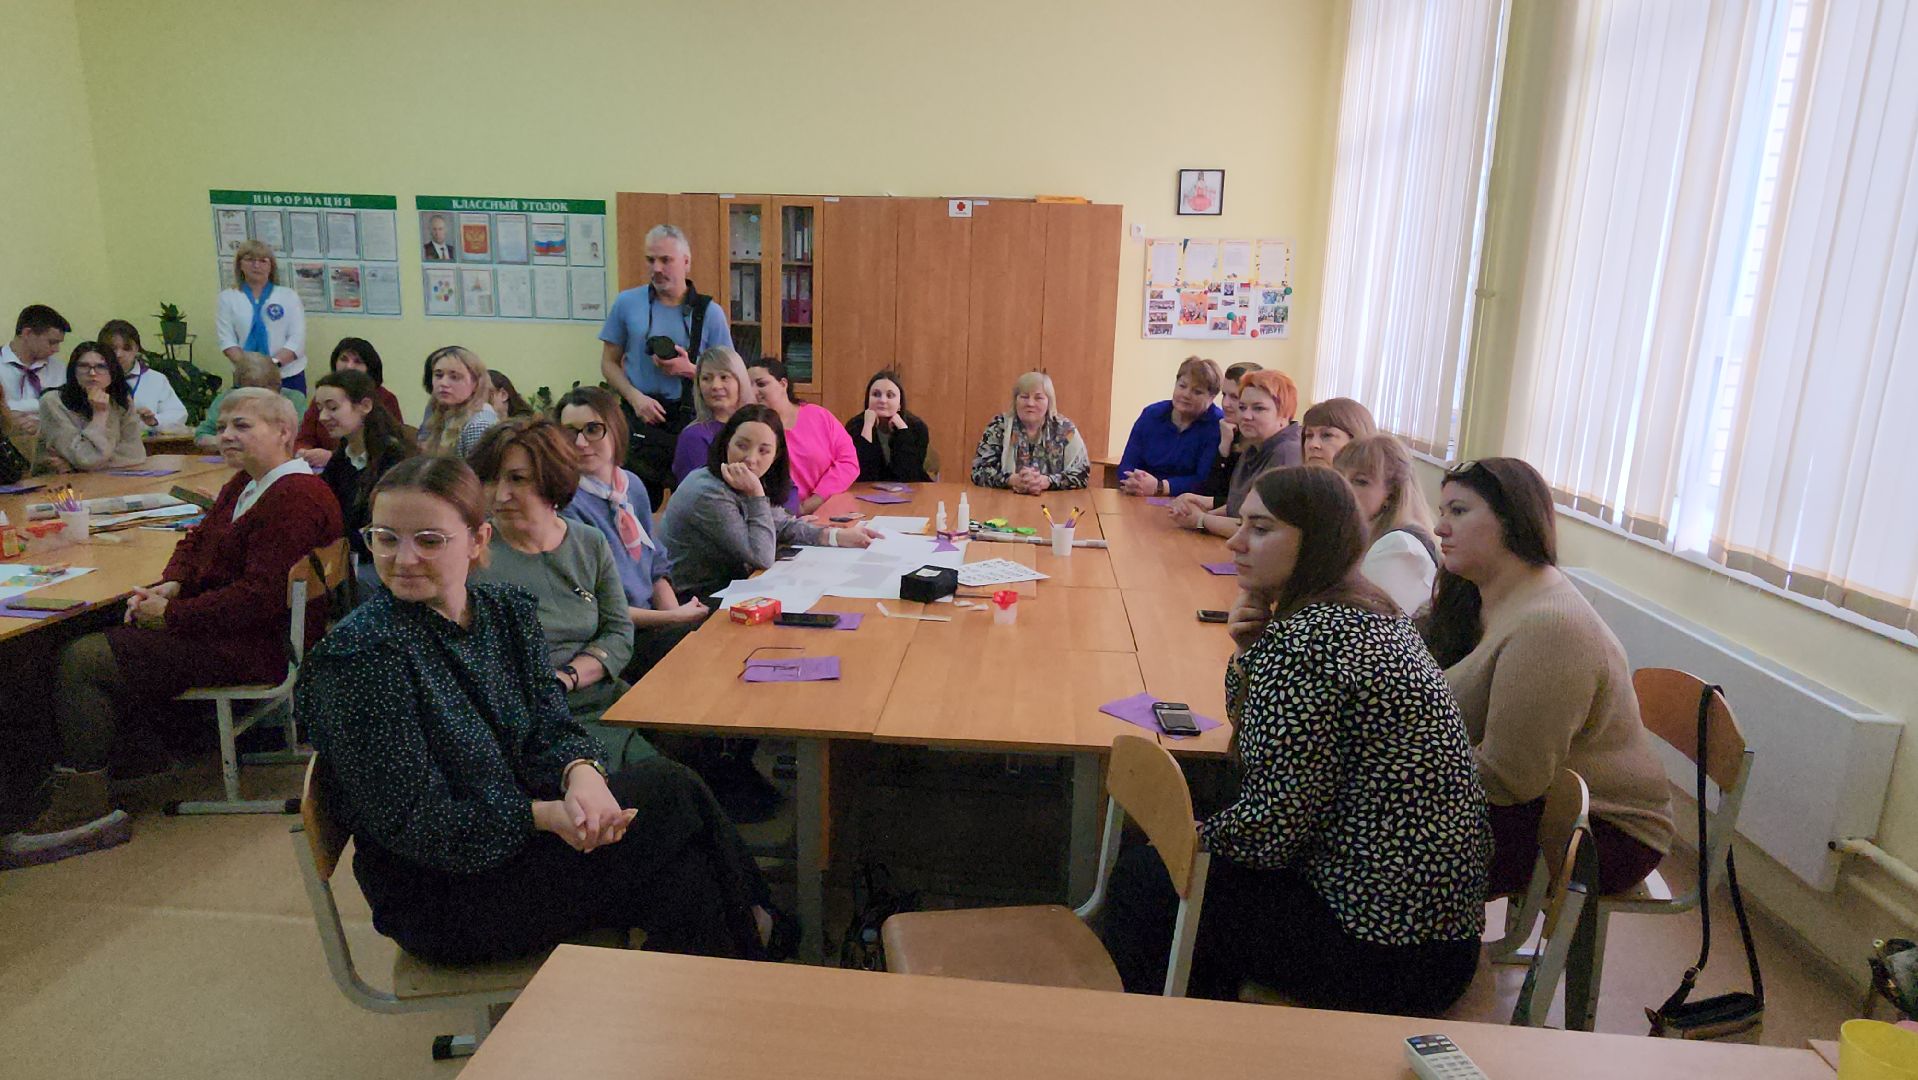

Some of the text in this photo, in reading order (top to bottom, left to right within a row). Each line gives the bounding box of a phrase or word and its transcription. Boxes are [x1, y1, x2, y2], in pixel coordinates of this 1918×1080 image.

[253, 194, 351, 207] ИНФОРМАЦИЯ
[452, 199, 568, 212] КЛАССНЫЙ УГОЛОК
